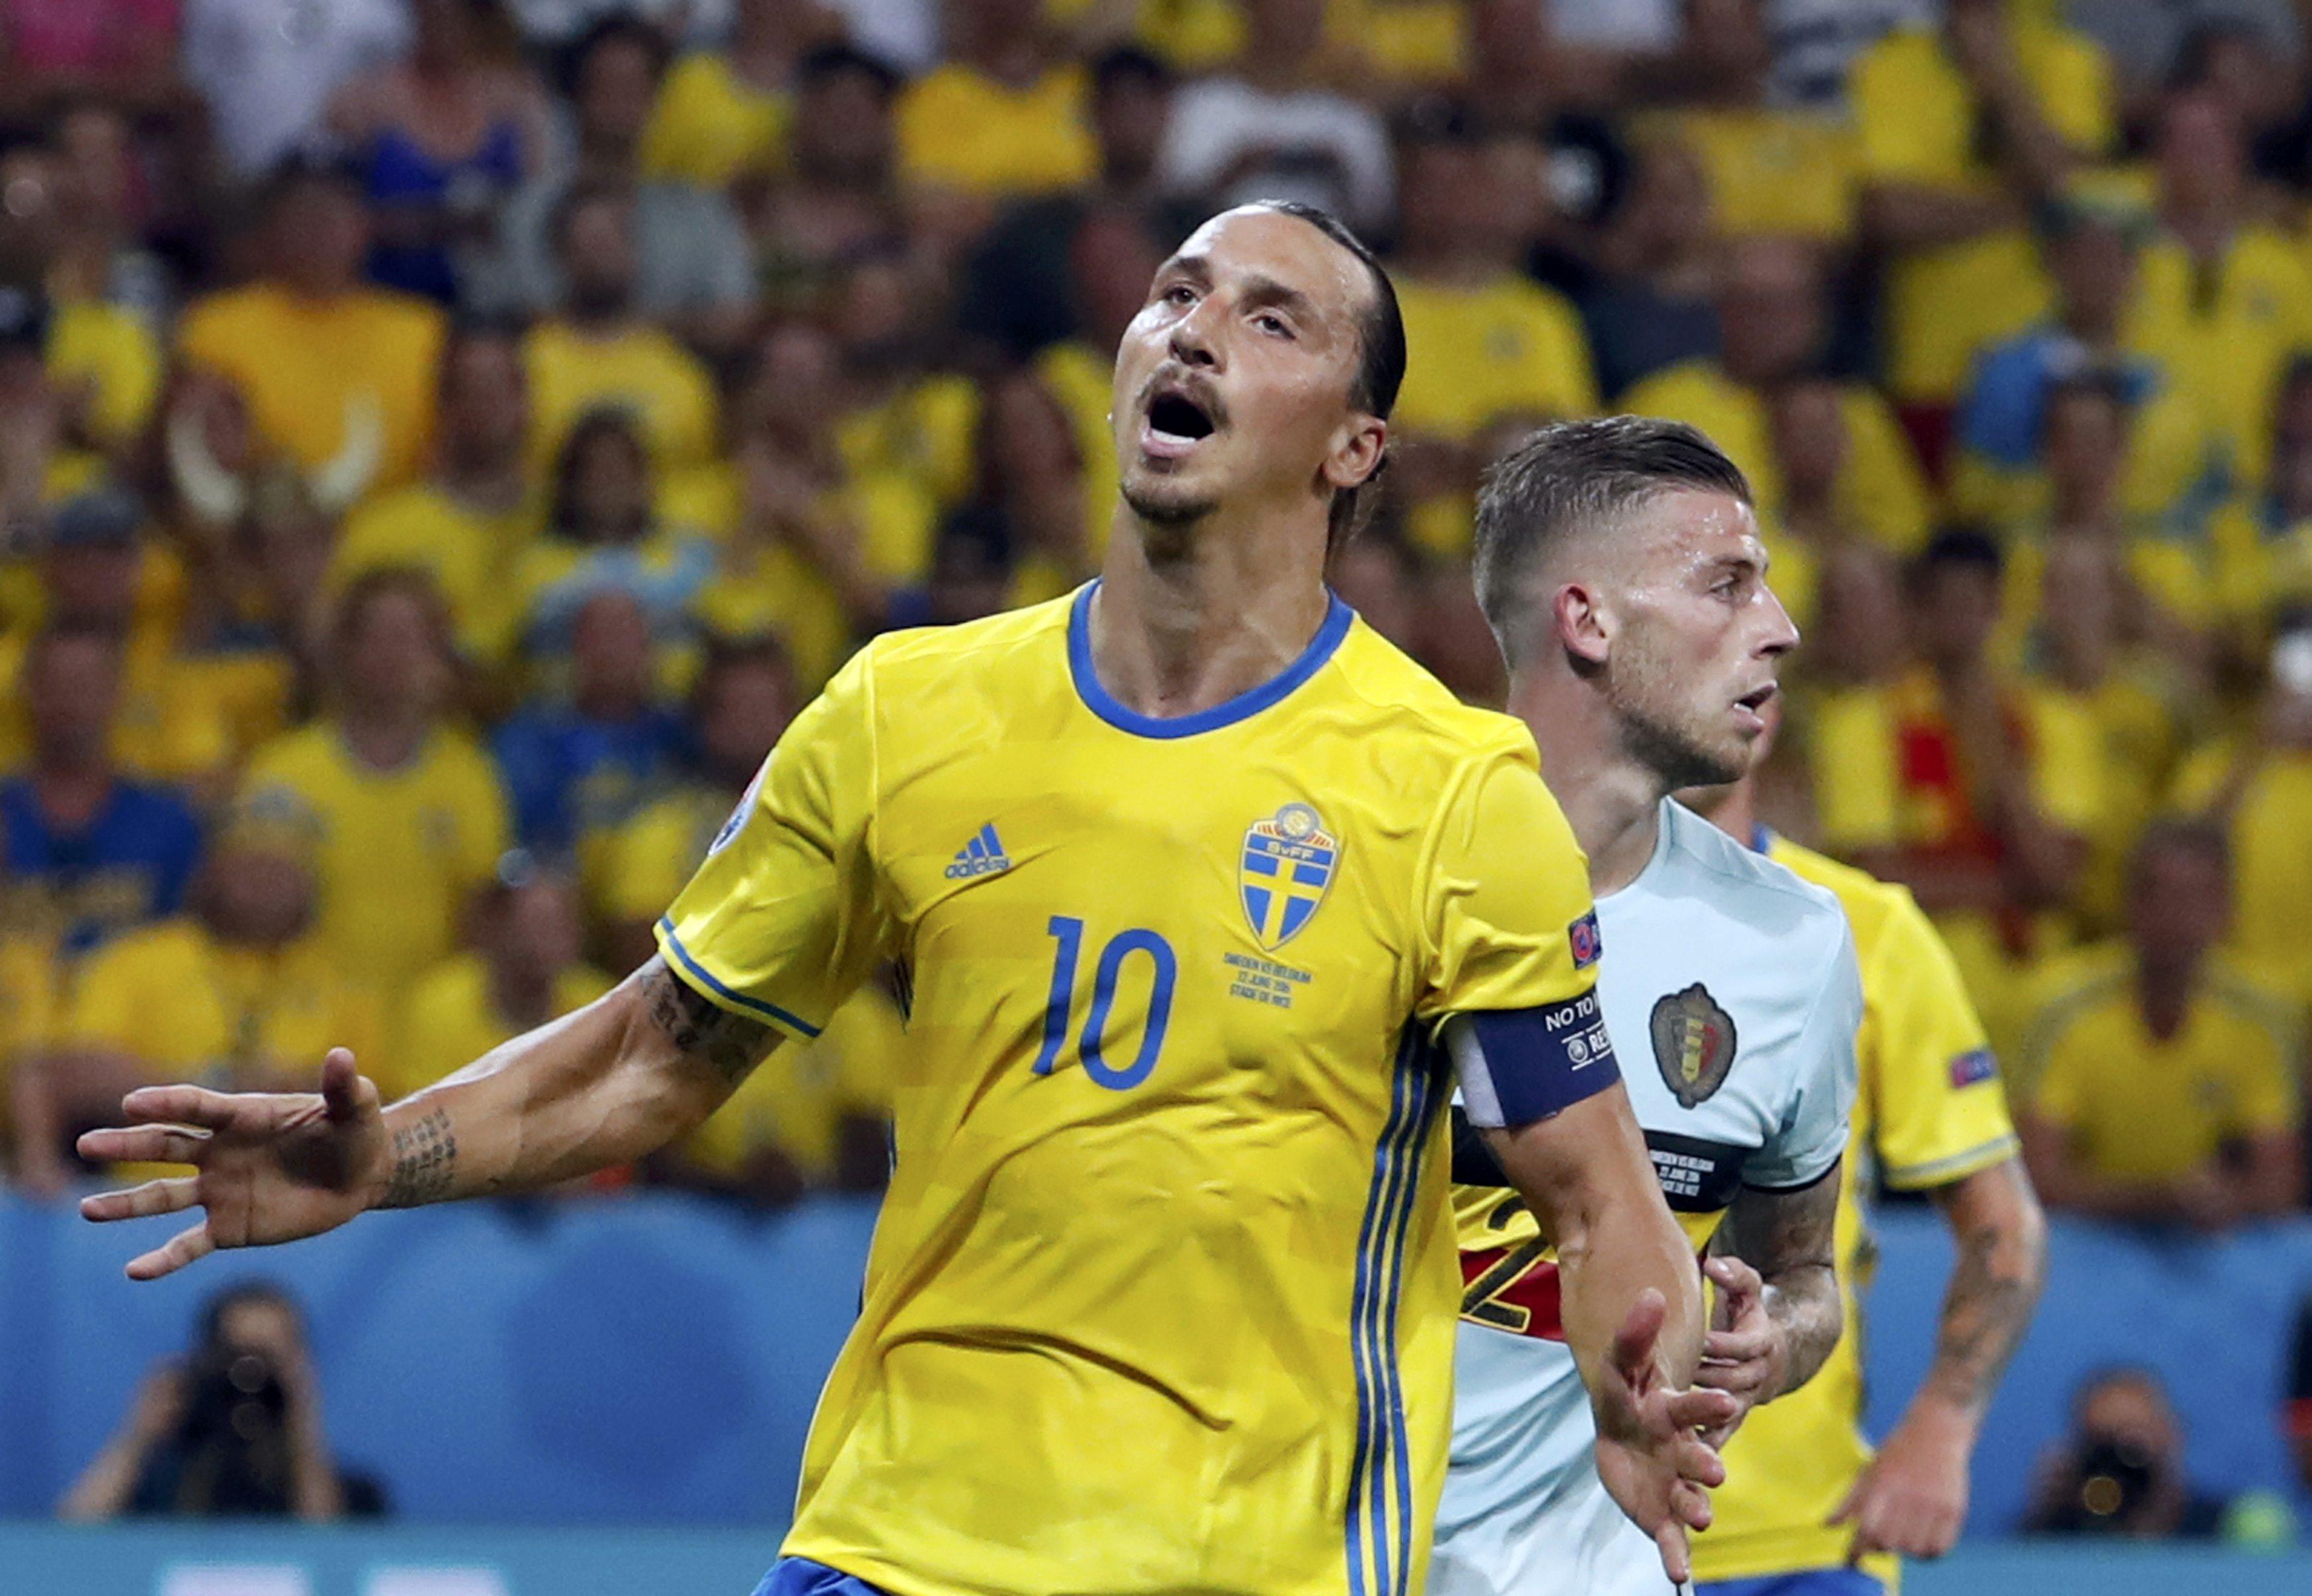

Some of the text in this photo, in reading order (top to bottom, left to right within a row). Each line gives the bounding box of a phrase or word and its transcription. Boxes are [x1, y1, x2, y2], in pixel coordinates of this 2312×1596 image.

[945, 859, 1009, 879] adidas
[1031, 915, 1176, 1090] 10
[1545, 1007, 1575, 1032] NO
[1575, 996, 1594, 1018] TO
[1588, 1028, 1610, 1052] RE
[1458, 1192, 1550, 1332] 2
